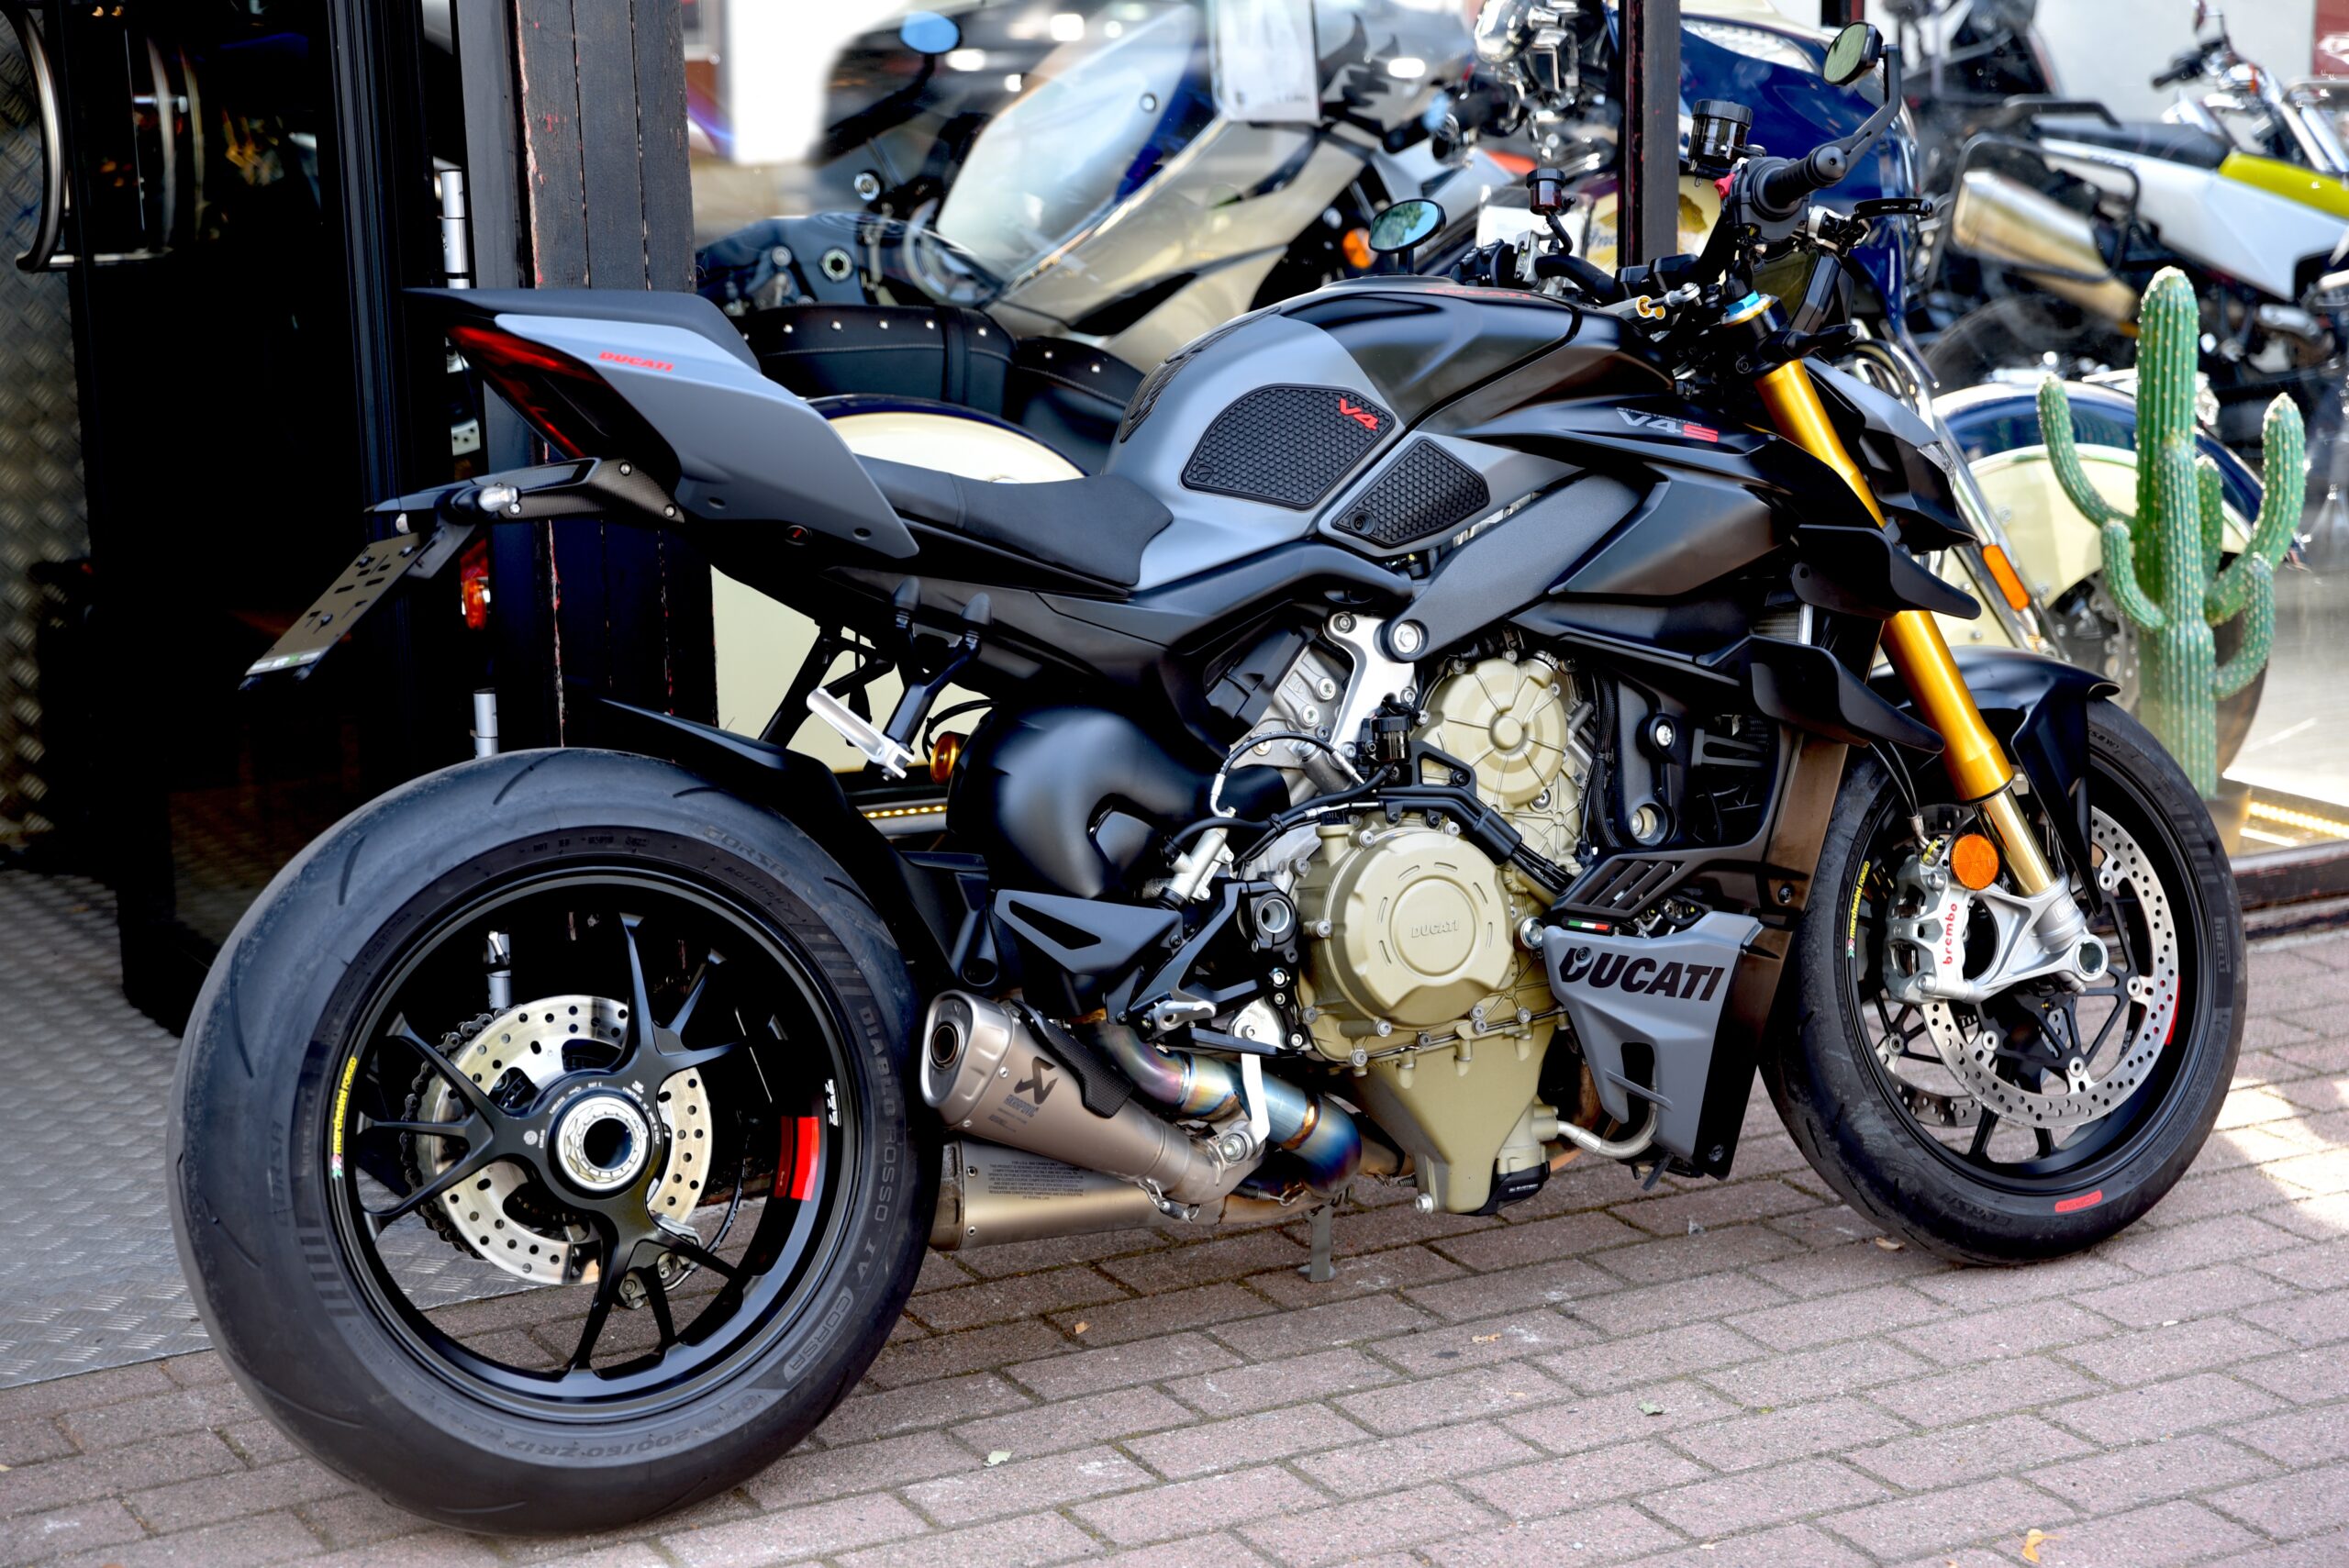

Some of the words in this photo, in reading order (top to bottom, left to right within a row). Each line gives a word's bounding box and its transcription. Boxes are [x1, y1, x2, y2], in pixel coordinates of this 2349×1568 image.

[598, 351, 674, 373] DUCATI
[1339, 397, 1379, 431] V4
[1617, 410, 1719, 443] V4S
[1849, 887, 1863, 938] marchesini
[1857, 861, 1871, 889] FORGED
[1411, 918, 1459, 939] DUCATI
[1943, 903, 1958, 964] brembo
[2214, 917, 2232, 973] PIRELLI
[1559, 947, 1726, 1002] DUCATI
[859, 1007, 896, 1118] DIABLO
[332, 1089, 349, 1154] marchesini
[341, 1056, 358, 1090] FORGED
[874, 1127, 897, 1222] ROSSO
[788, 1295, 854, 1371] CORSA
[585, 1429, 691, 1458] 200/60
